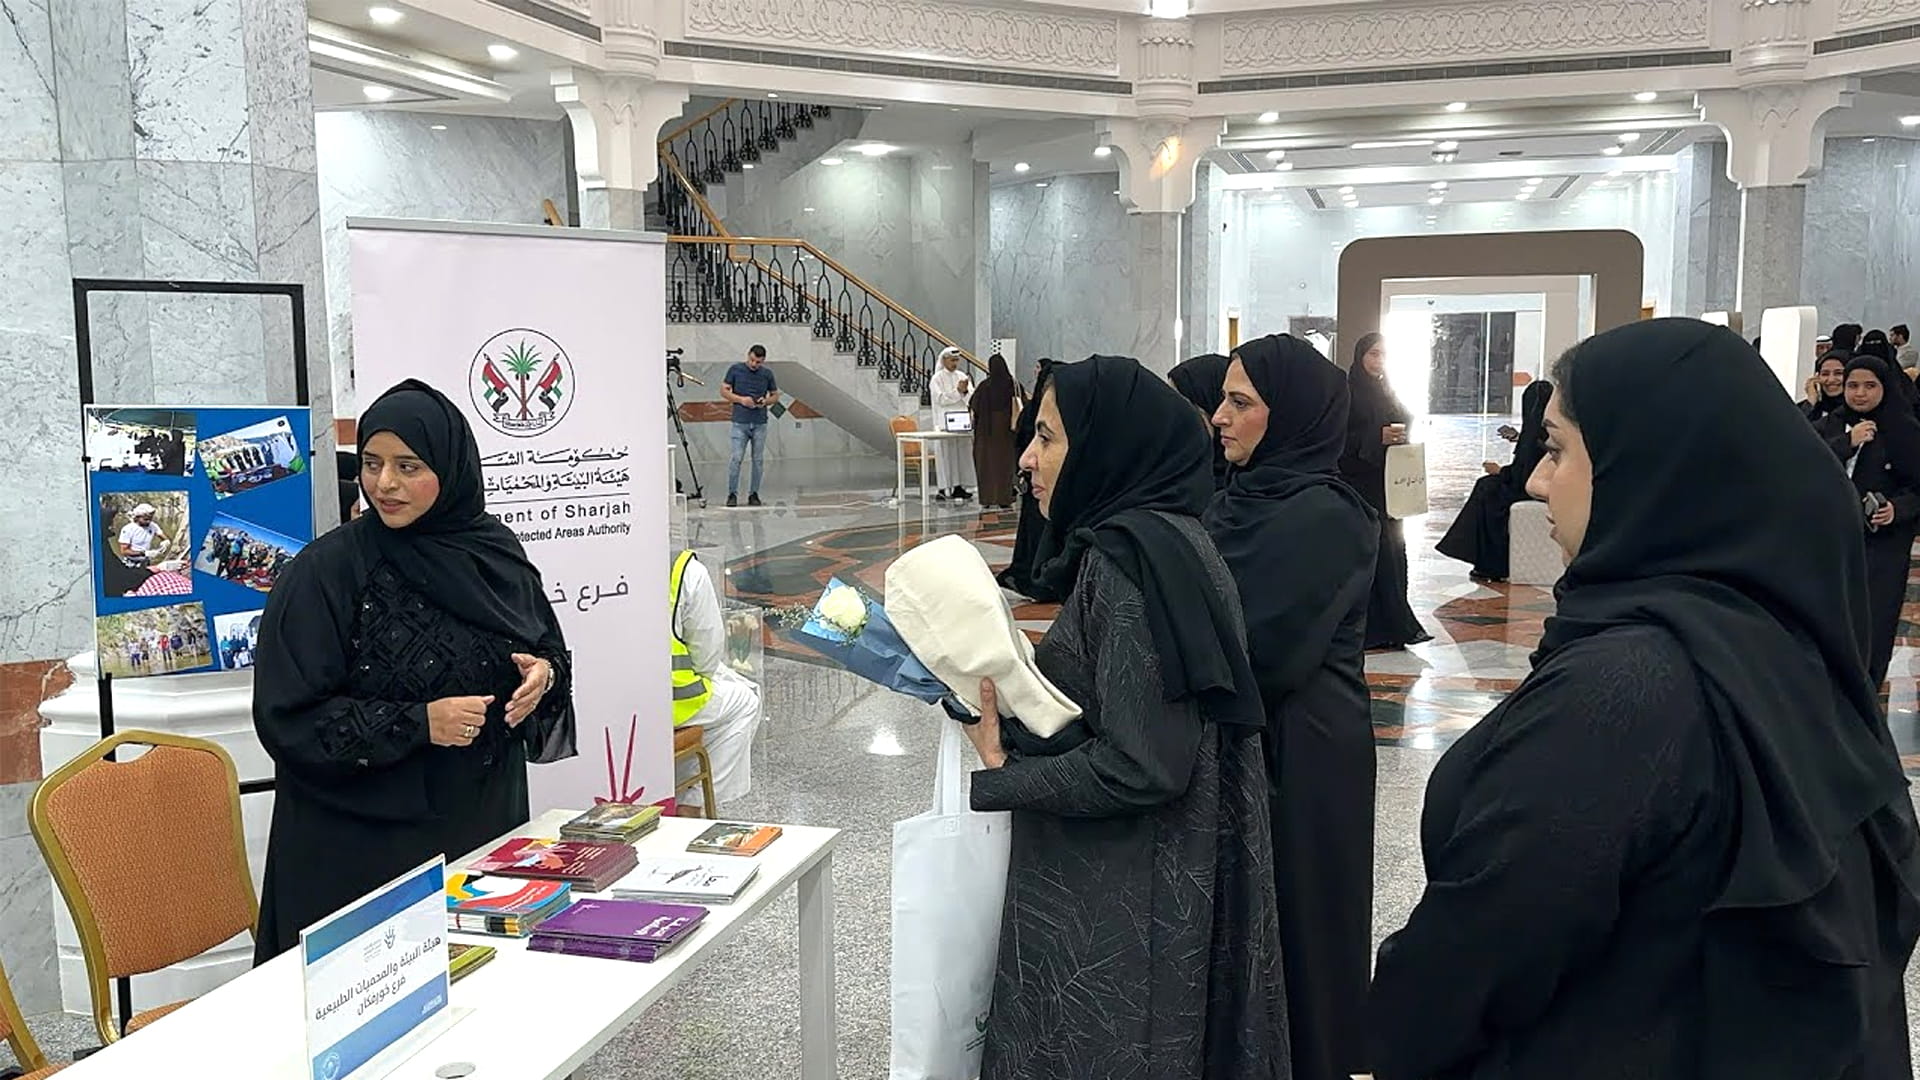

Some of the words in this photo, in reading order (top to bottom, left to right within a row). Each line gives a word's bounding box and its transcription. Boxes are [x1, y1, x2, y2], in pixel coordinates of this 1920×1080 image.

[541, 505, 558, 520] of
[565, 501, 631, 518] Sharjah
[515, 529, 551, 543] otected
[554, 526, 585, 540] Areas
[587, 522, 631, 537] Authority
[576, 574, 629, 612] فرع
[400, 945, 422, 968] البيئة
[422, 935, 442, 956] هيئة
[355, 961, 399, 994] والمحميات
[391, 975, 407, 995] فرع
[315, 985, 354, 1021] الطبيعية
[357, 983, 390, 1017] خورفكان
